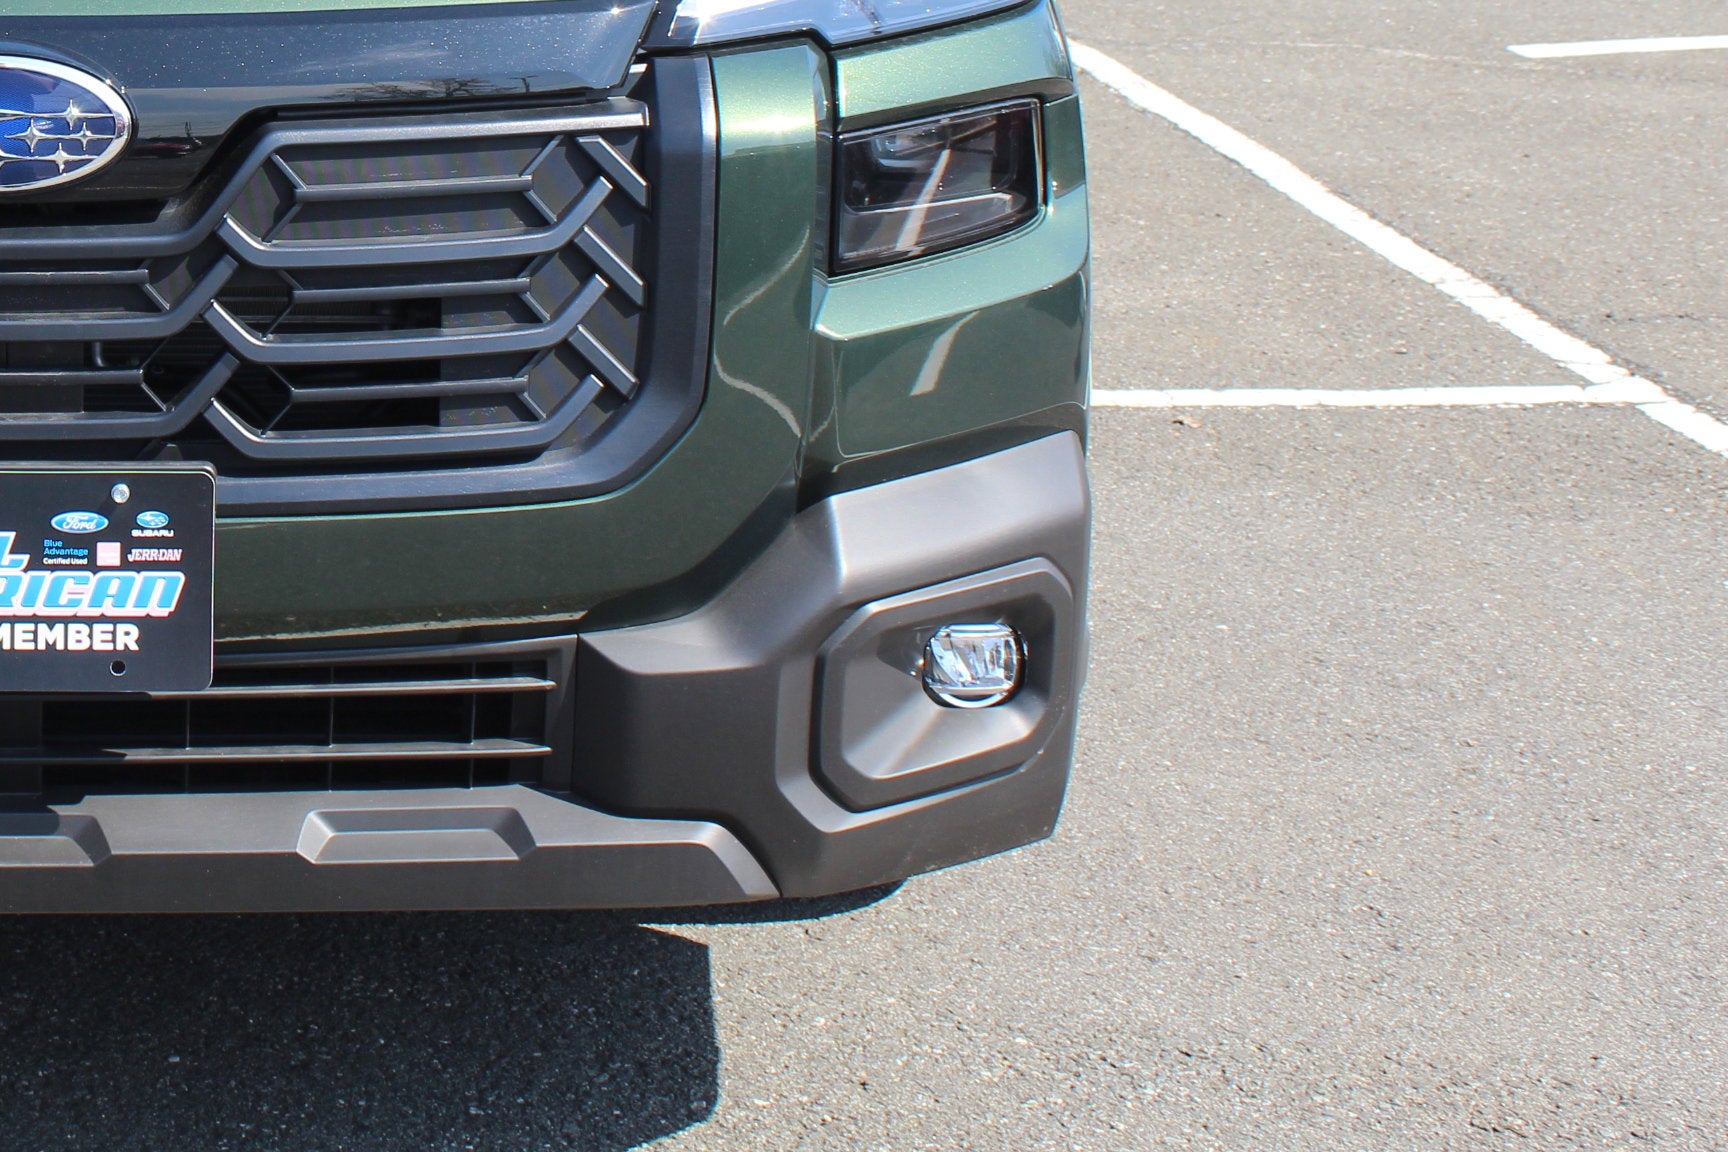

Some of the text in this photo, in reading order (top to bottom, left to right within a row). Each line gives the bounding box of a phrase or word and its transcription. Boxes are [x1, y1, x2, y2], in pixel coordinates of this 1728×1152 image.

[62, 515, 98, 530] Ford
[131, 529, 174, 537] SUBARU
[43, 539, 63, 547] Blue
[43, 548, 89, 557] Advantage
[42, 557, 70, 565] Certified
